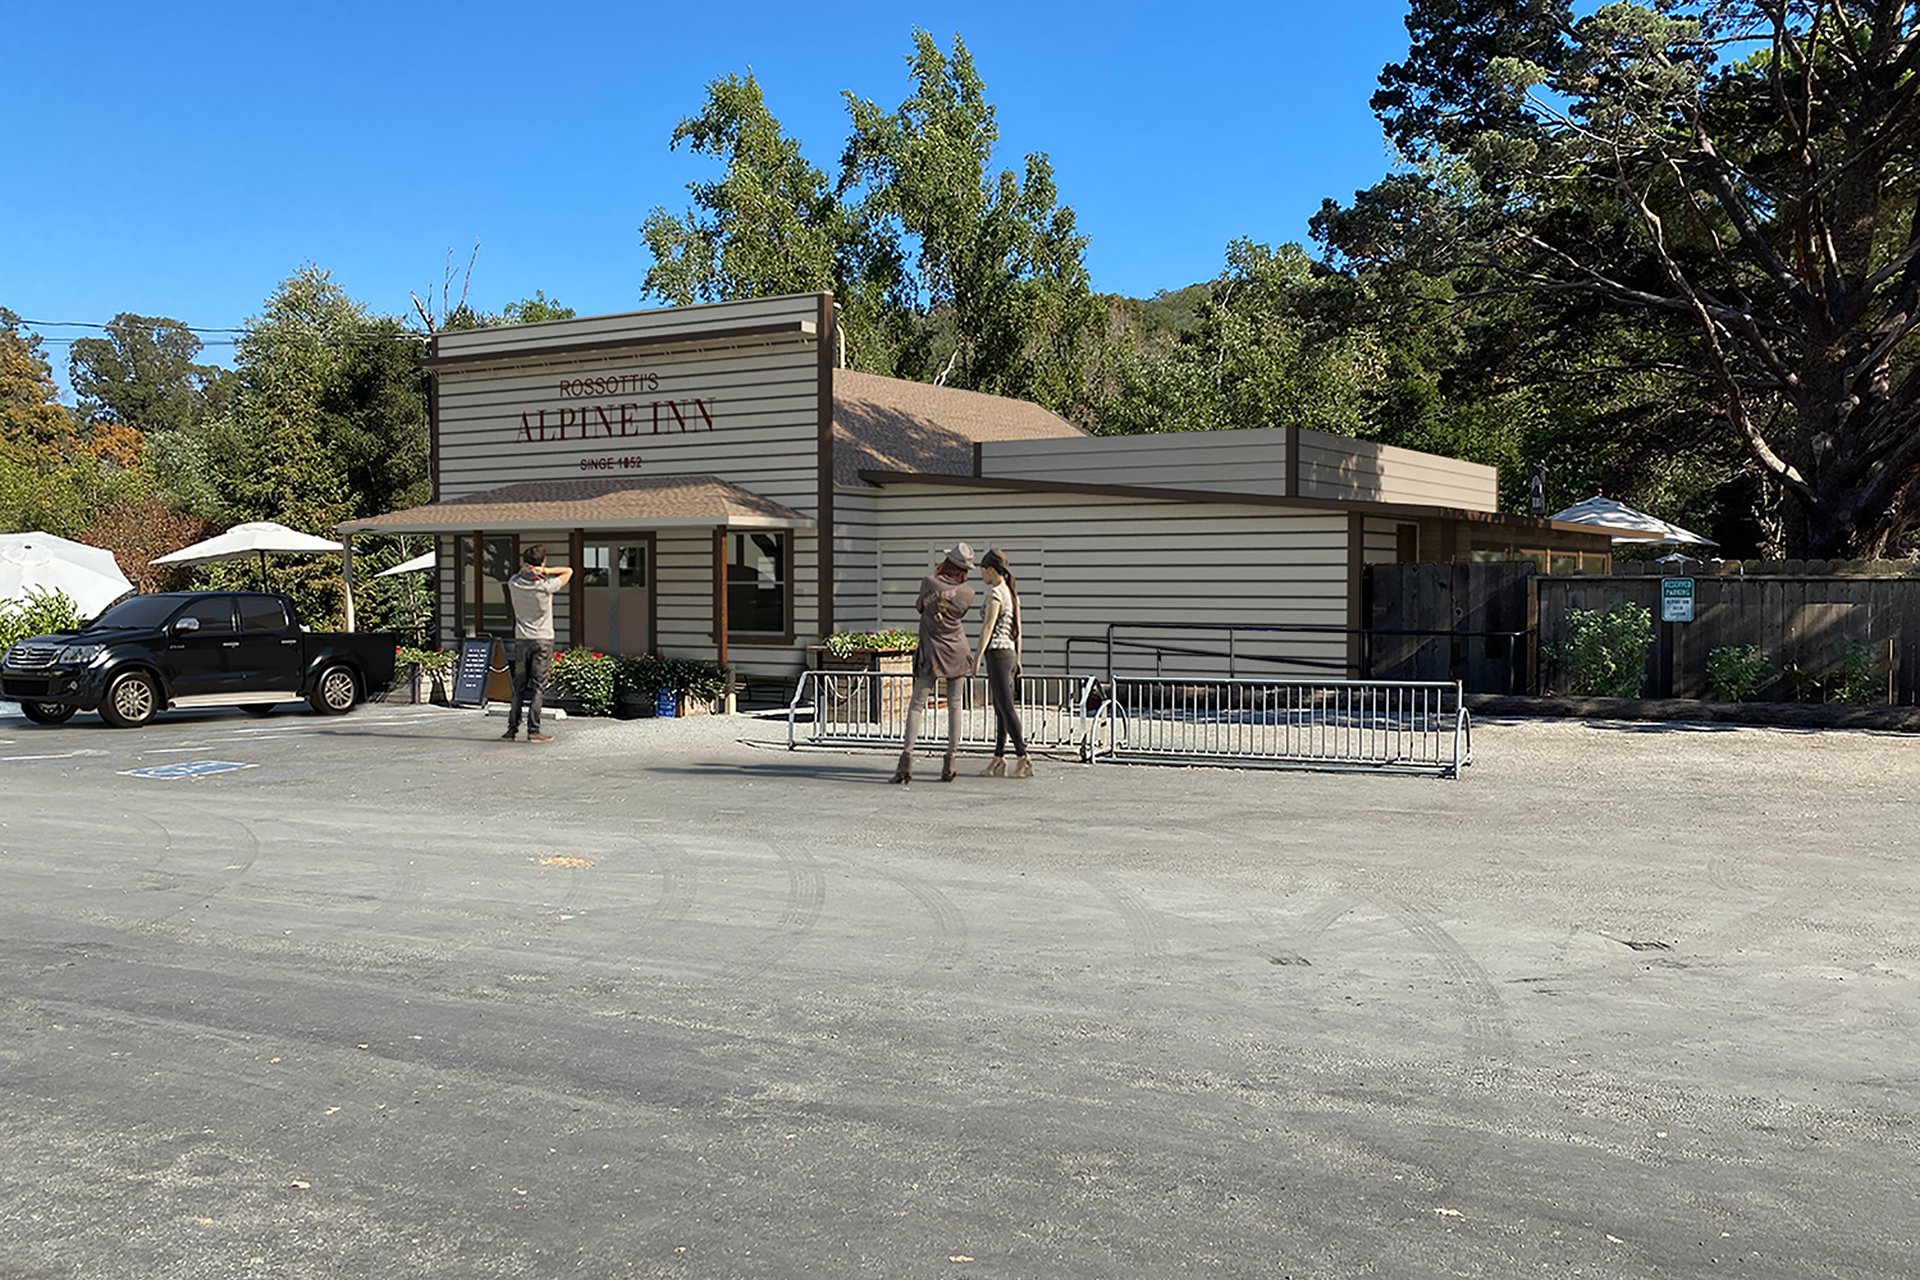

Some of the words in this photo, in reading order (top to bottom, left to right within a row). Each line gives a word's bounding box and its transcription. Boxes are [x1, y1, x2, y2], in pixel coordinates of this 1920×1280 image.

[560, 372, 660, 398] ROSSOTTI'S
[515, 403, 639, 444] ALPINE
[651, 397, 716, 436] INN
